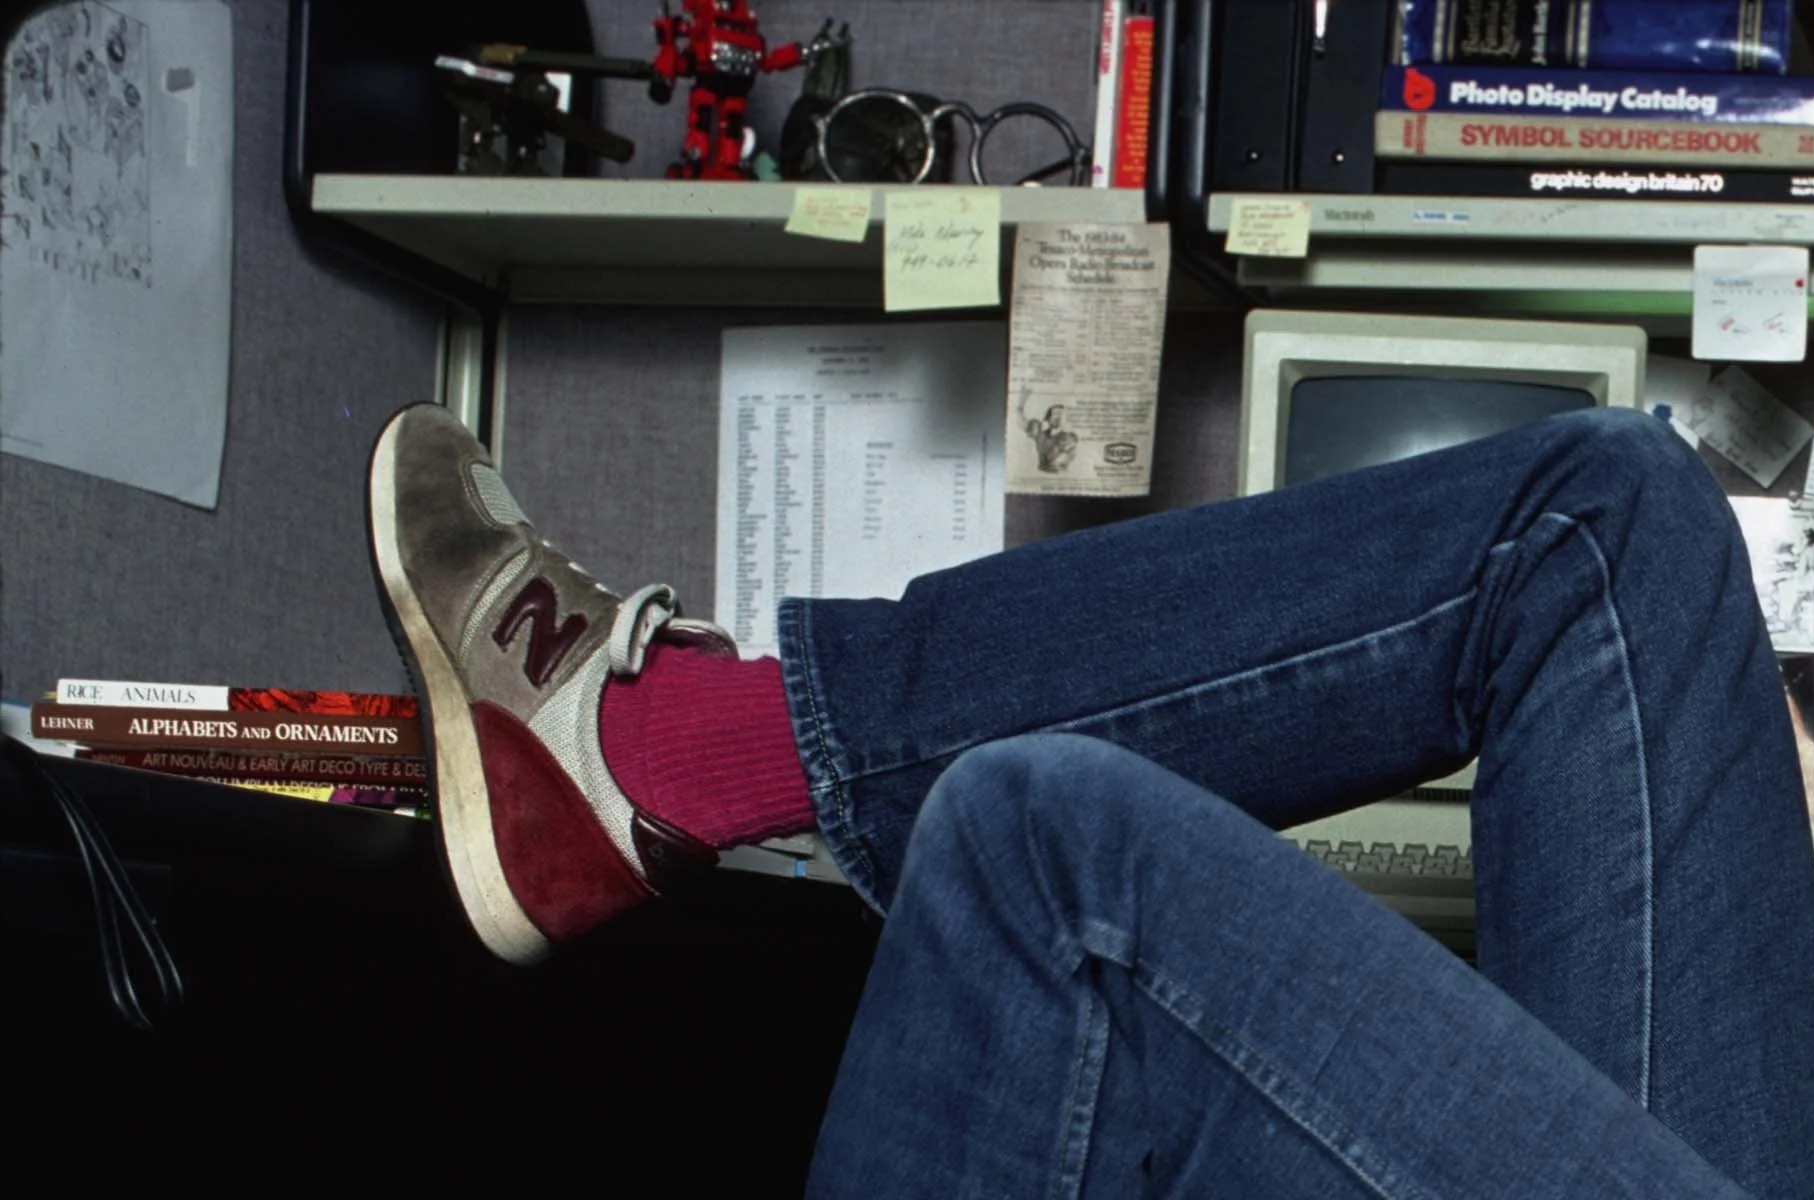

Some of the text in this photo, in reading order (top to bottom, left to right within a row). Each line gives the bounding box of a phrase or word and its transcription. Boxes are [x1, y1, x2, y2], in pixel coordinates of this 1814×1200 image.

[1450, 82, 1718, 115] Photo Display Catalog
[1461, 123, 1761, 153] SYMBOL SOURCEBOOK
[1531, 173, 1592, 193] graphic
[1593, 173, 1647, 193] design
[1648, 173, 1699, 192] britain
[492, 577, 588, 688] N
[120, 687, 196, 704] ANIMALS
[40, 716, 398, 744] LEHNER ALPHABETS AND ORNAMENTS
[142, 753, 167, 767] ART
[170, 754, 235, 770] NOUVEAU
[236, 757, 248, 771] &
[249, 757, 287, 773] EARLY
[291, 758, 315, 774] ART
[319, 759, 355, 775] DECO
[358, 760, 389, 776] TYPE
[391, 761, 402, 776] &
